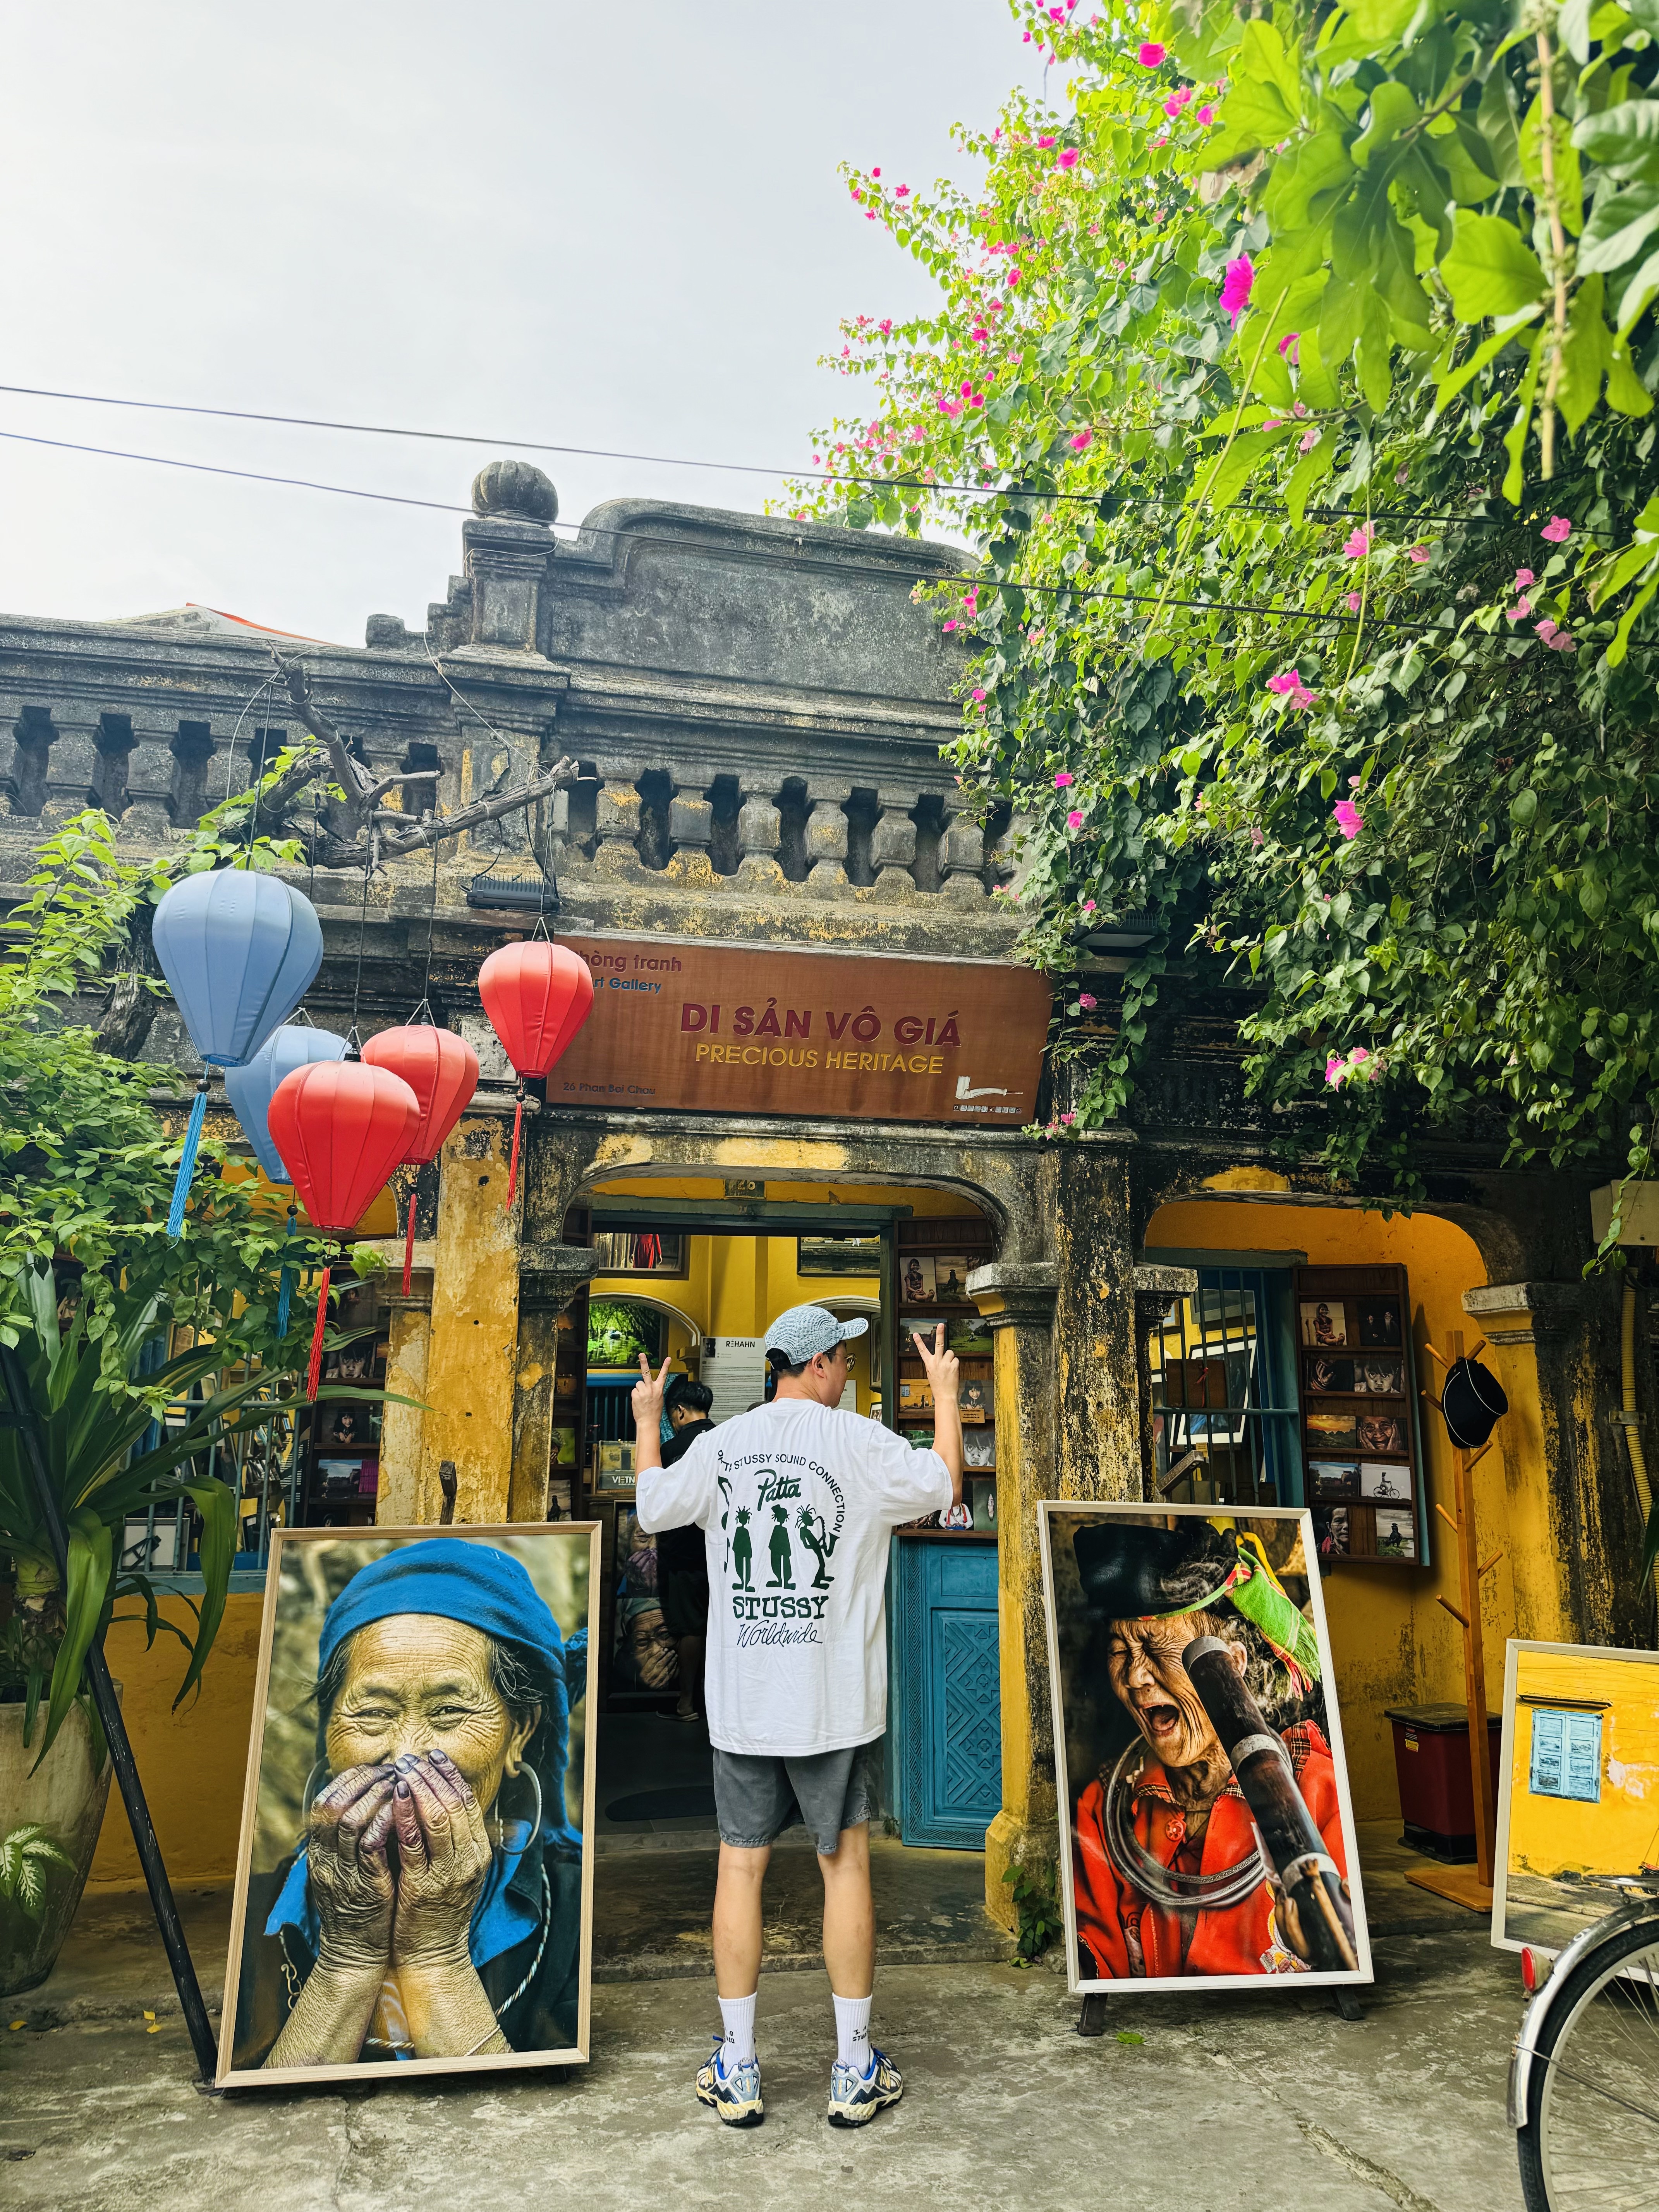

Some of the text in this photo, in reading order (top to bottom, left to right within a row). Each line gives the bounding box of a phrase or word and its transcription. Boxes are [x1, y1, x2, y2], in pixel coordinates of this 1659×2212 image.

[577, 950, 682, 973] hòng tranh
[593, 977, 661, 994] rt Gallery
[681, 997, 962, 1047] DI SẢN VÔ GIÁ
[696, 1042, 944, 1074] PRECIOUS HERITAGE
[563, 1082, 656, 1094] 26 Phan Boi Chau
[726, 1340, 755, 1348] RÉHAHN
[734, 1454, 772, 1470] STUSSY
[775, 1454, 806, 1466] SOUND
[809, 1461, 845, 1532] CONNECTION
[754, 1469, 802, 1511] Patta
[733, 1595, 829, 1620] STUSSY
[737, 1620, 823, 1648] Worldwide
